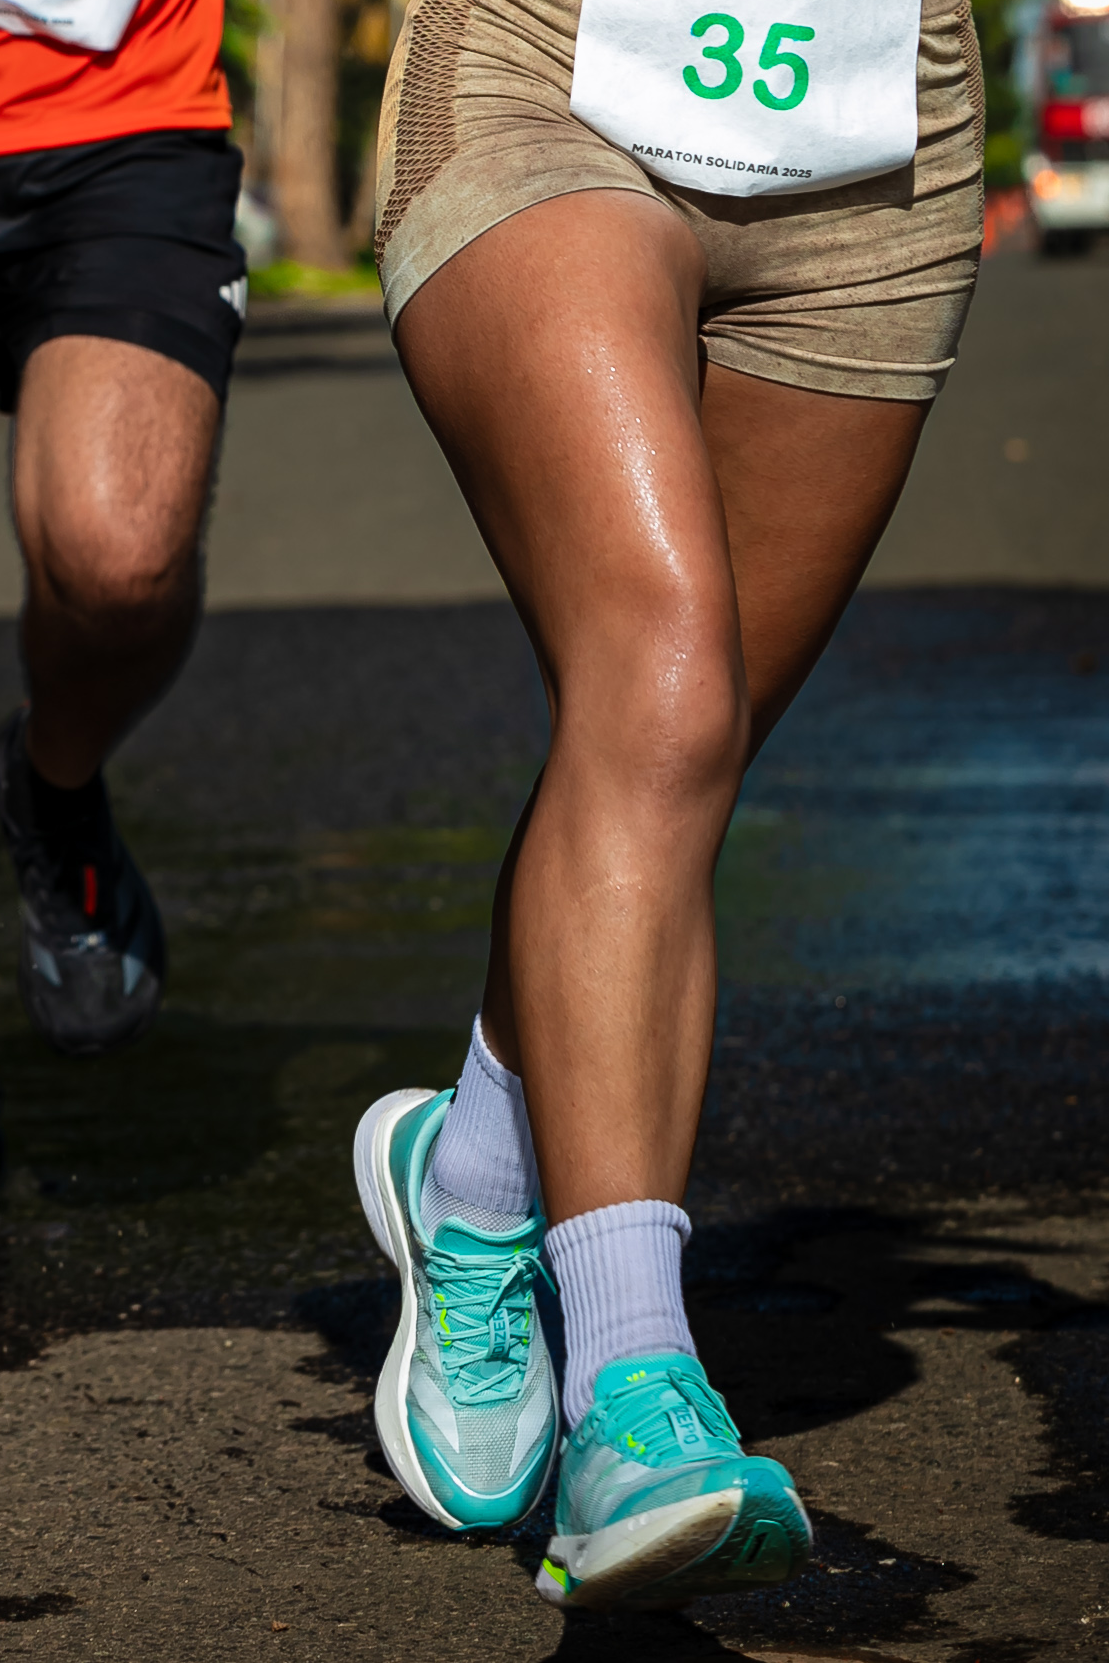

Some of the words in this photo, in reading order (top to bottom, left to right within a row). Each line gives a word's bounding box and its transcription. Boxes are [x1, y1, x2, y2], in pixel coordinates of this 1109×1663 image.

[682, 12, 815, 111] 35
[632, 143, 703, 165] MARATON
[705, 156, 779, 176] SOLIDARIA
[781, 167, 812, 179] 2025
[492, 1308, 506, 1356] DIZER
